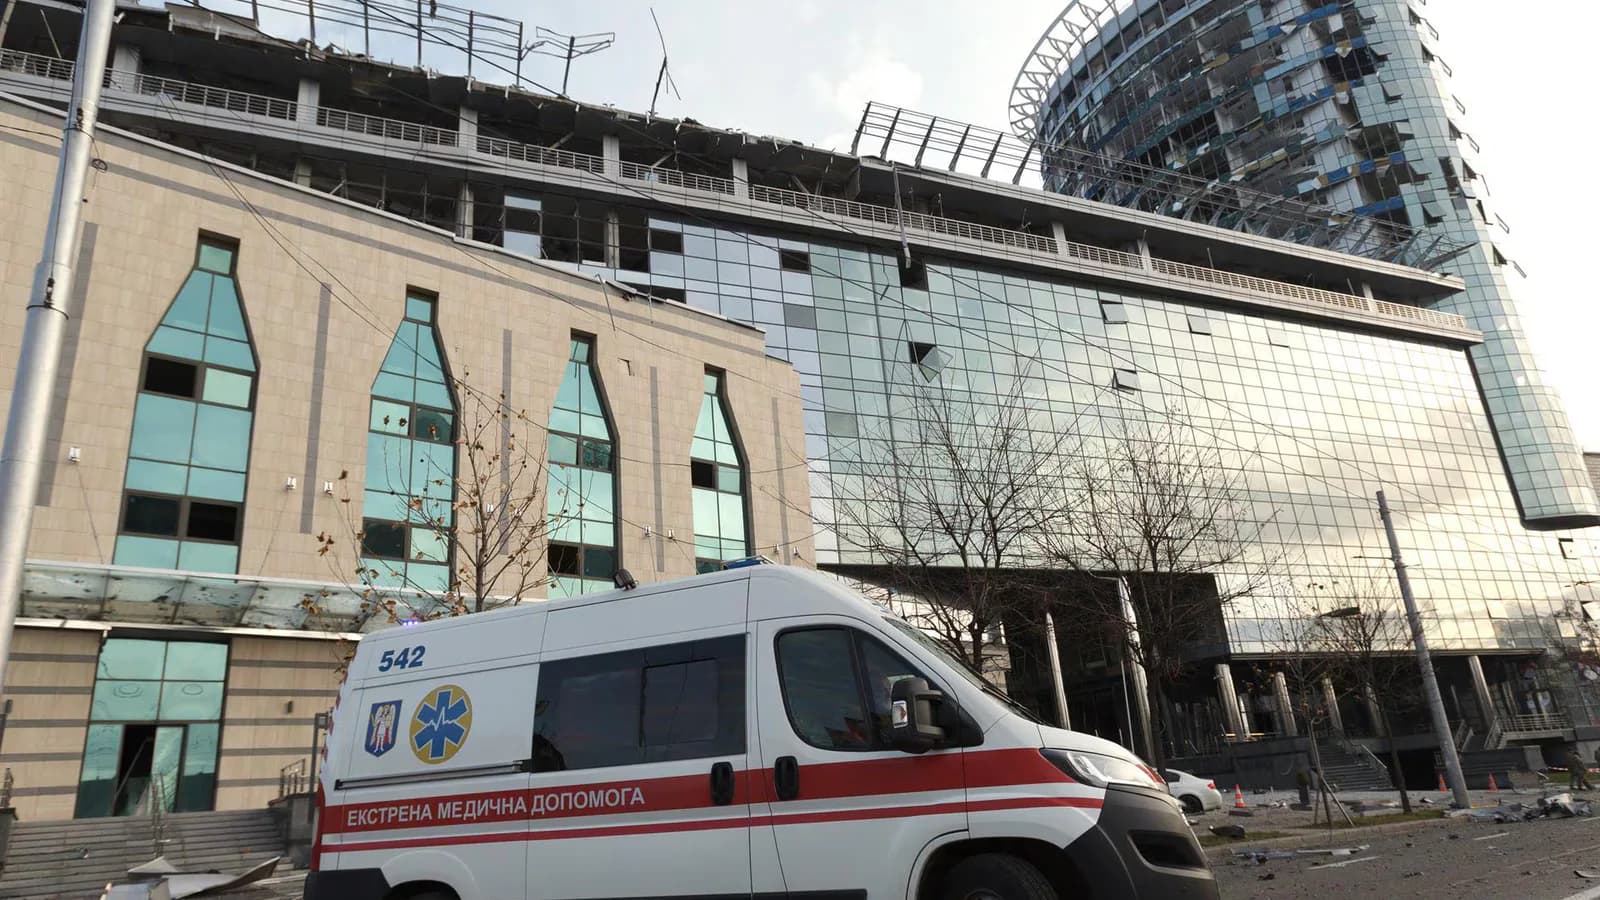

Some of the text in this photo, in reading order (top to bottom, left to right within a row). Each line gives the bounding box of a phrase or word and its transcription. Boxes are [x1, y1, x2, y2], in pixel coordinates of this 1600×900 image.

[379, 645, 425, 672] 542
[347, 788, 645, 826] ЕКСТРЕНА МЕДИЧНА ДОПОМОГА
